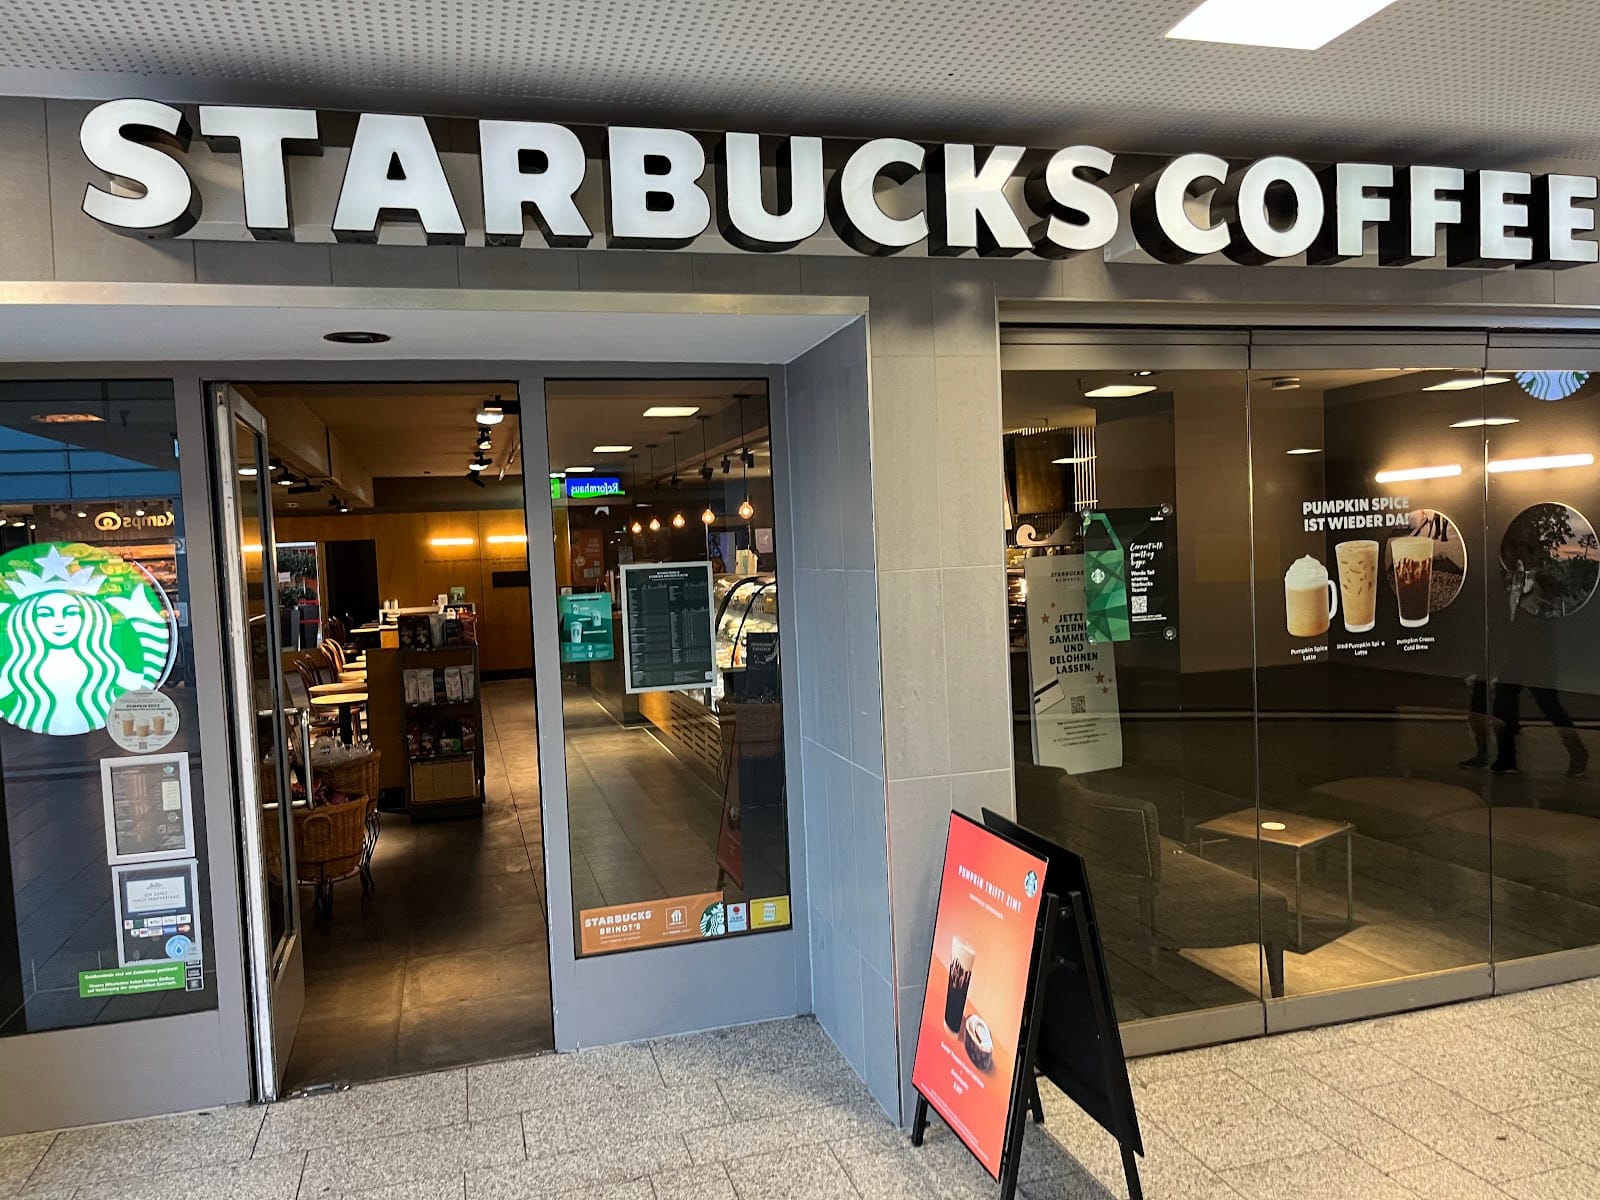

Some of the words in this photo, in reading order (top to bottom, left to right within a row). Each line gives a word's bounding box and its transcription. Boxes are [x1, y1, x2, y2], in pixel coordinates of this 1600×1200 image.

[80, 98, 1118, 251] STARBUCKS
[1154, 153, 1599, 262] COFFEE
[1302, 498, 1369, 515] PUMPKIN
[1371, 496, 1409, 511] SPICE
[1304, 517, 1326, 532] IST
[1327, 514, 1384, 530] WIEDER
[1385, 512, 1410, 527] DA!
[1058, 613, 1083, 623] JETZT
[1063, 643, 1084, 653] UND
[1290, 646, 1313, 656] Pumpkin
[1348, 642, 1371, 650] Pumpkin
[1049, 652, 1098, 664] BELOHNEN
[1056, 663, 1094, 675] LASSEN.
[958, 864, 984, 890] PUMPKIN
[985, 880, 1005, 904] TRIFFT
[1005, 894, 1022, 913] ZIMT
[584, 910, 652, 928] STARBUCKS
